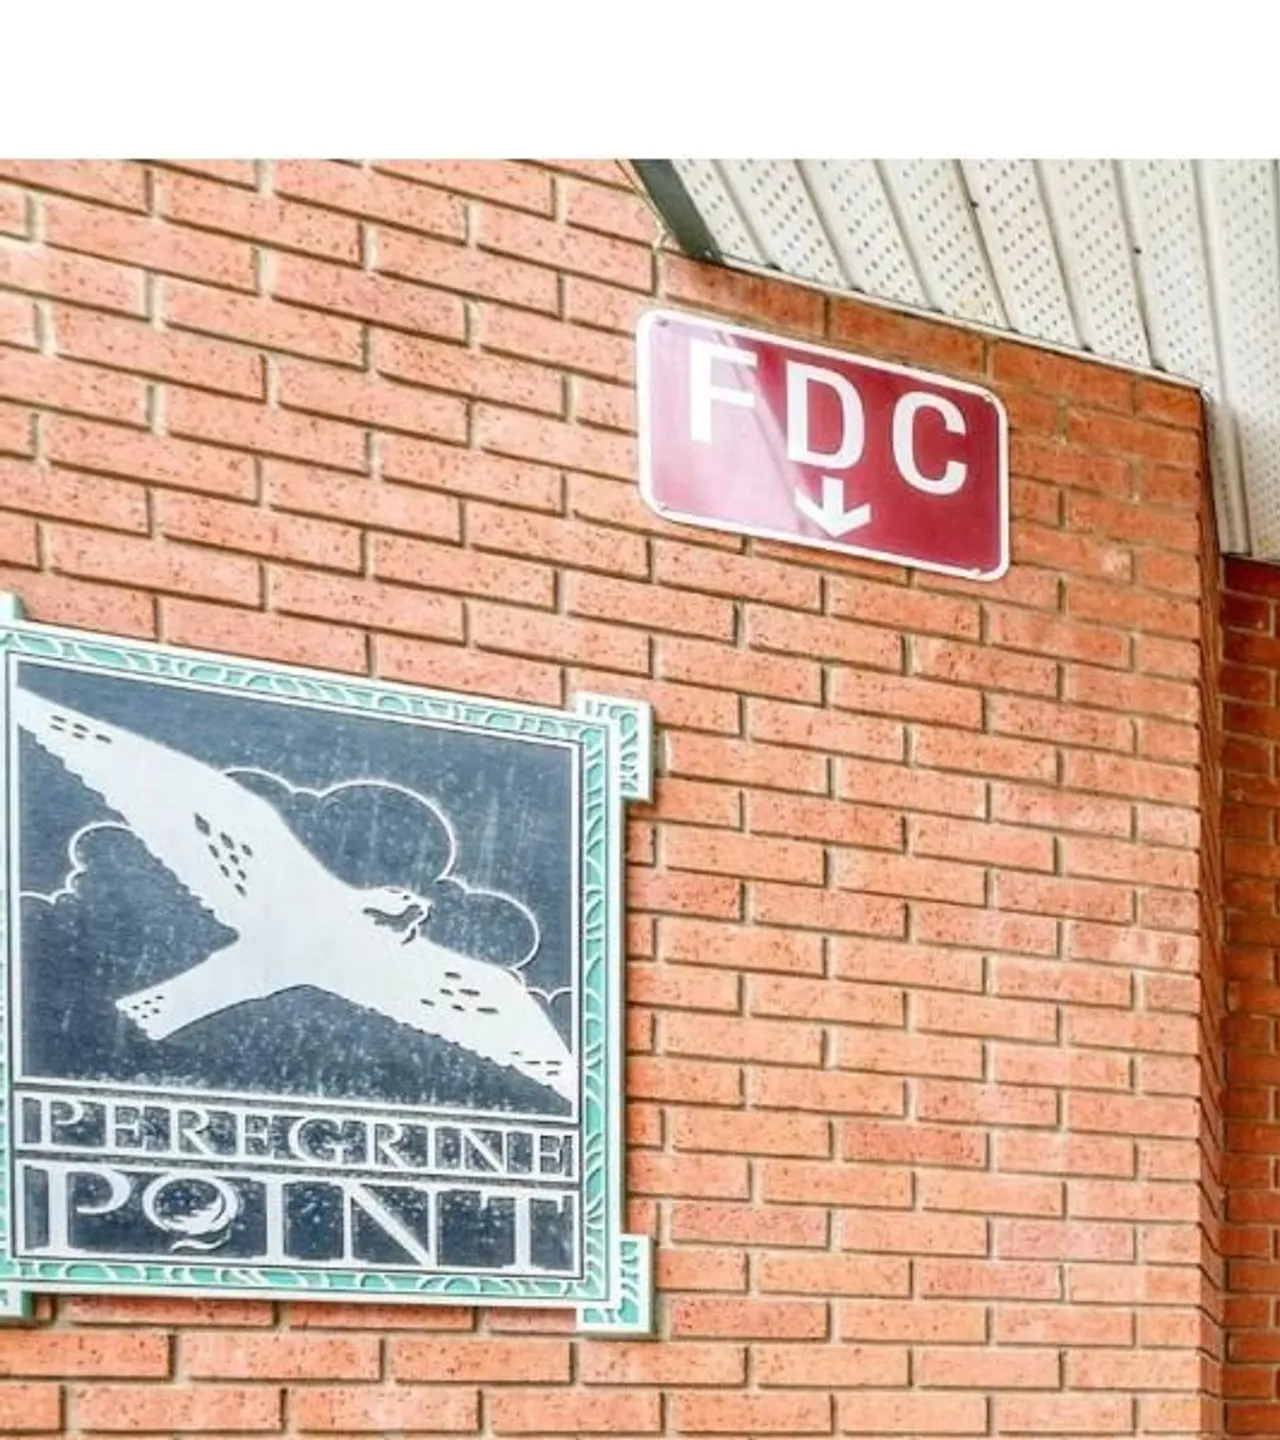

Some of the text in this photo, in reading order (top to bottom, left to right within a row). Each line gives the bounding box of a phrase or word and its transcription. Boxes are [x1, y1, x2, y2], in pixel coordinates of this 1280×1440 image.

[688, 339, 968, 496] FDC
[38, 1096, 579, 1177] PEREGRINE
[40, 1163, 566, 1272] POINT
